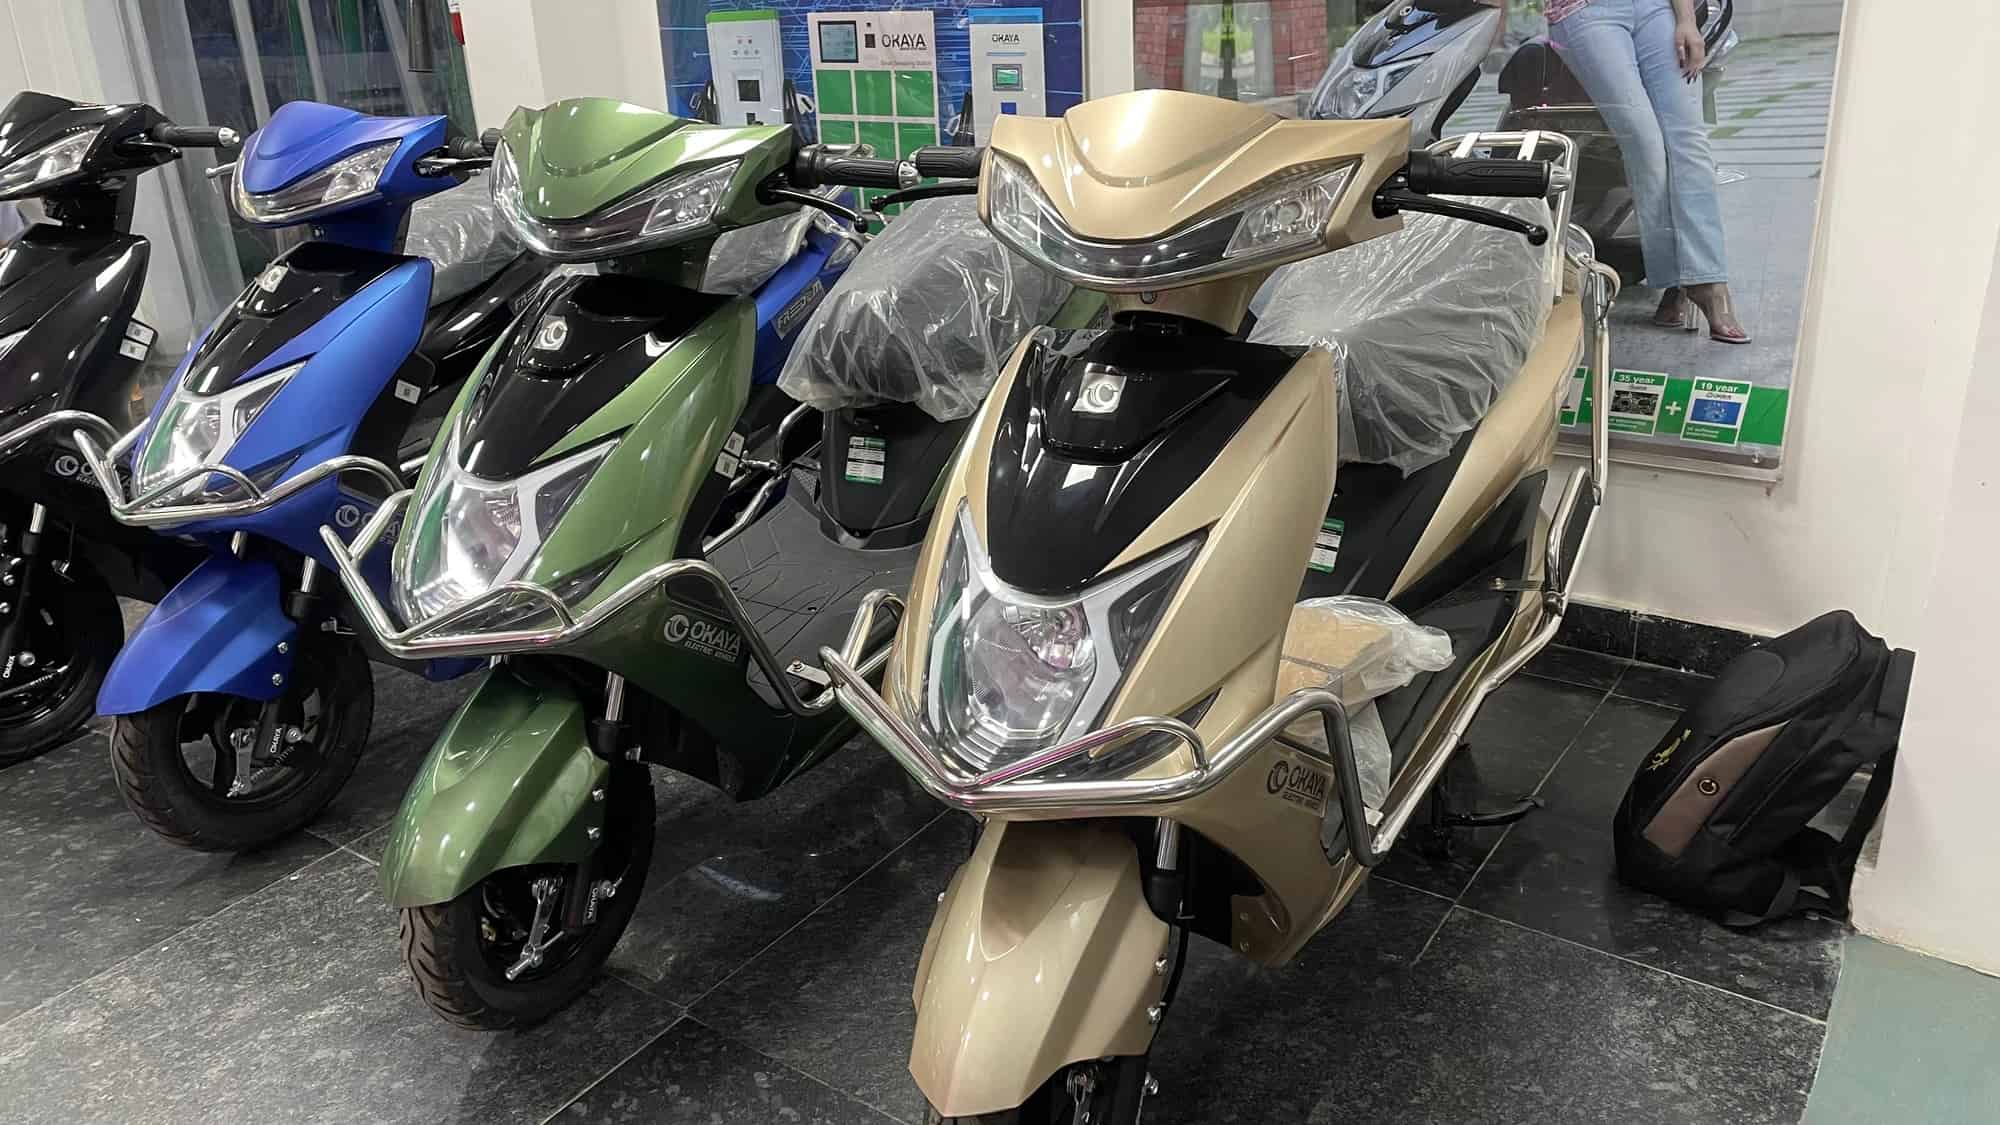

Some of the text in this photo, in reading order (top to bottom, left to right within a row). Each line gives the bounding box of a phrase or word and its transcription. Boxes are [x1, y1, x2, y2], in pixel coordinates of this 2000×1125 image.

[881, 33, 927, 48] OKAYA
[991, 33, 1020, 43] OKAYA
[1618, 374, 1656, 385] 35 year
[1715, 384, 1739, 393] year
[690, 620, 741, 657] OKAYA
[1289, 765, 1327, 801] OKAYA
